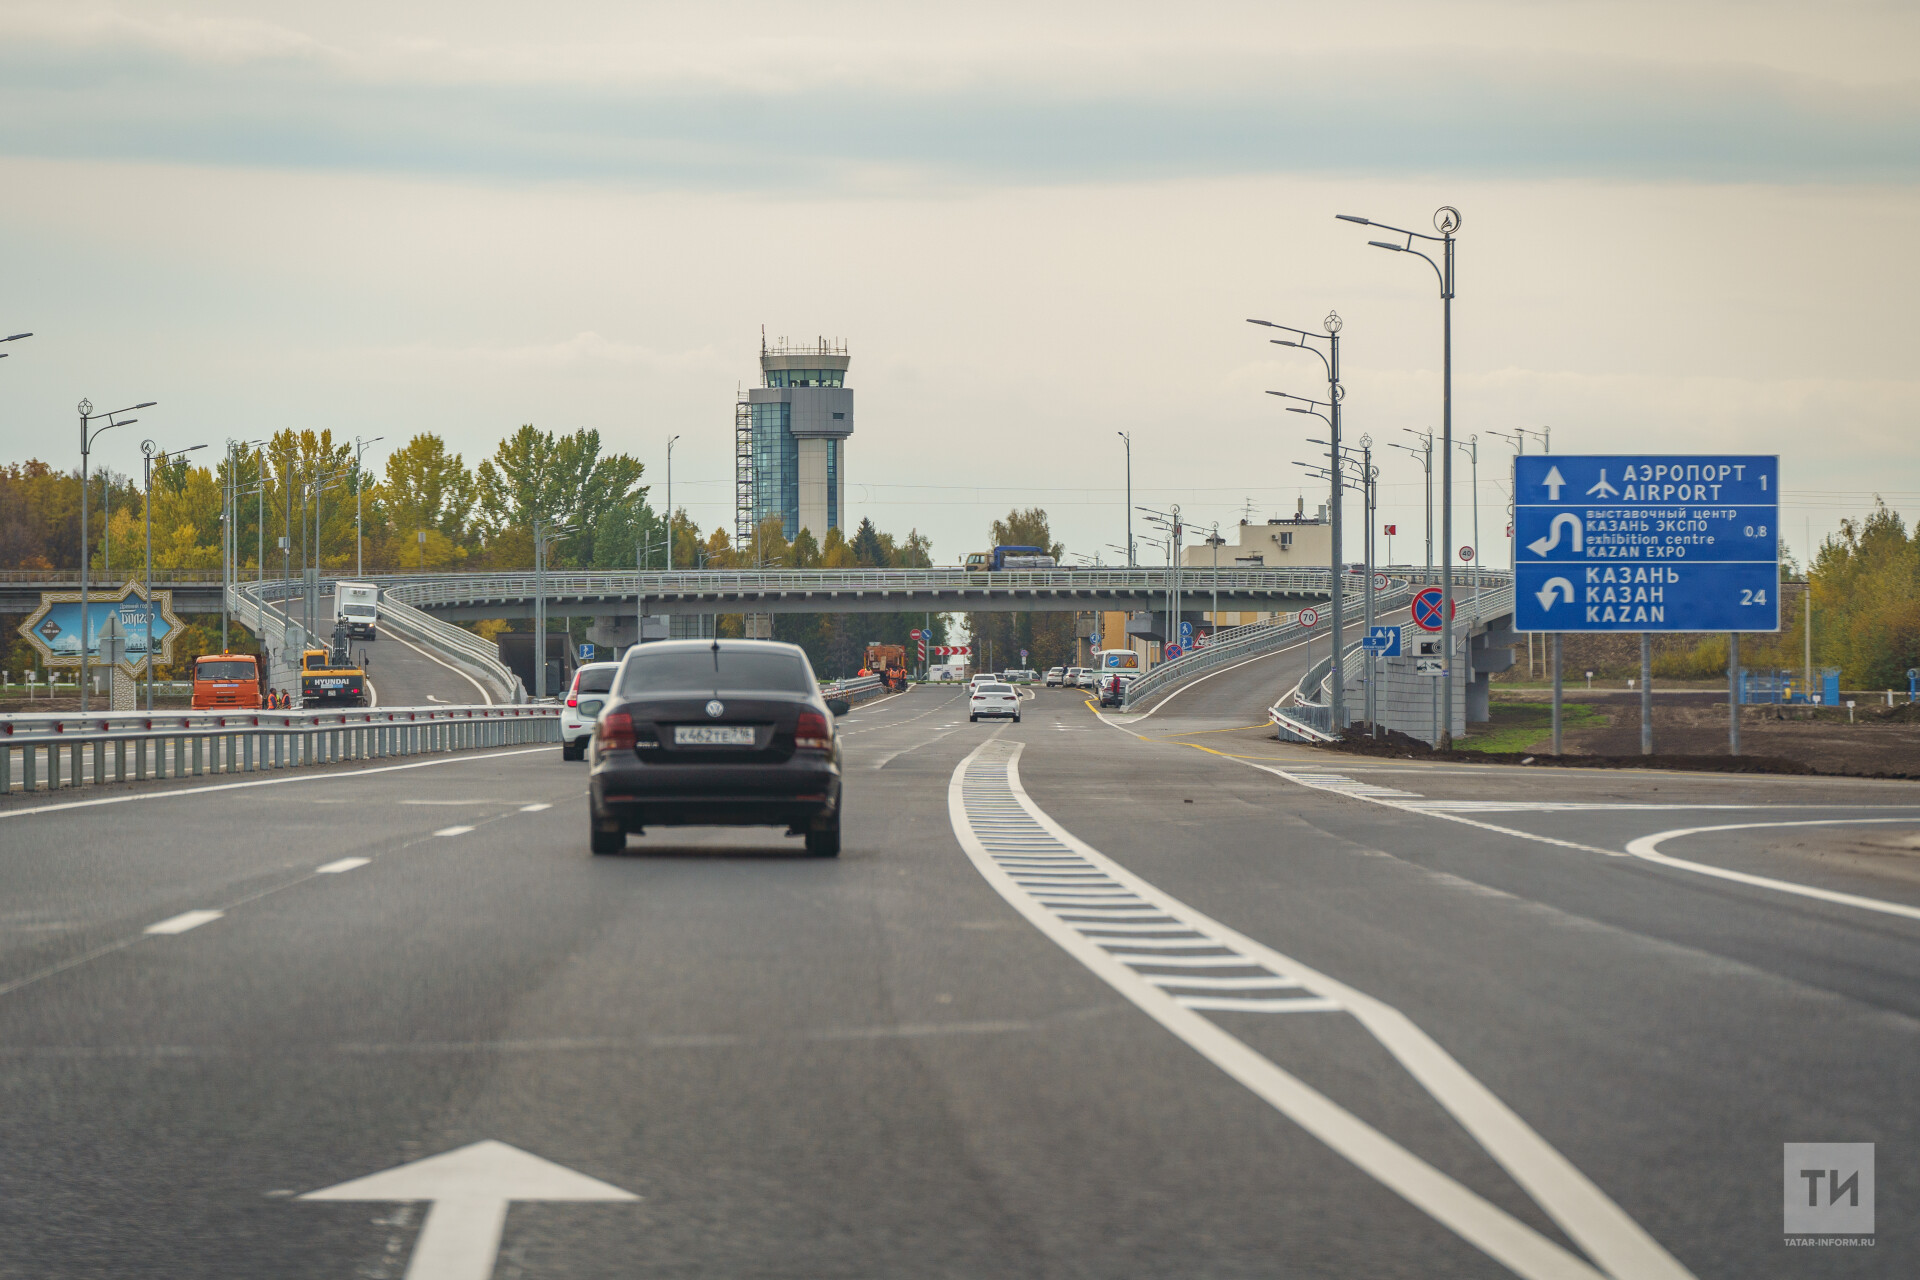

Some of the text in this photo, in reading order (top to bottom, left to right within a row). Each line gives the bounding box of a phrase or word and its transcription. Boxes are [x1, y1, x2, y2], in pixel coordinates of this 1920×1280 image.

[1622, 464, 1747, 482] АЭРОПОРТ
[1759, 474, 1768, 491] 1
[1622, 484, 1723, 501] AIRPORT
[1585, 507, 1738, 521] выставочный центр
[1585, 520, 1708, 532] КАЗАНЬ ЭКСПО
[1743, 525, 1768, 539] 0,8
[1585, 533, 1716, 545] exhibition centre
[1585, 546, 1687, 558] KAZAN EXPO
[1585, 566, 1681, 584] КАЗАНЬ
[1585, 586, 1664, 603] КАЗАН
[1739, 589, 1768, 606] 24
[1303, 613, 1314, 622] 70
[1585, 606, 1665, 623] KAZAN
[314, 678, 349, 686] HYUNDAI
